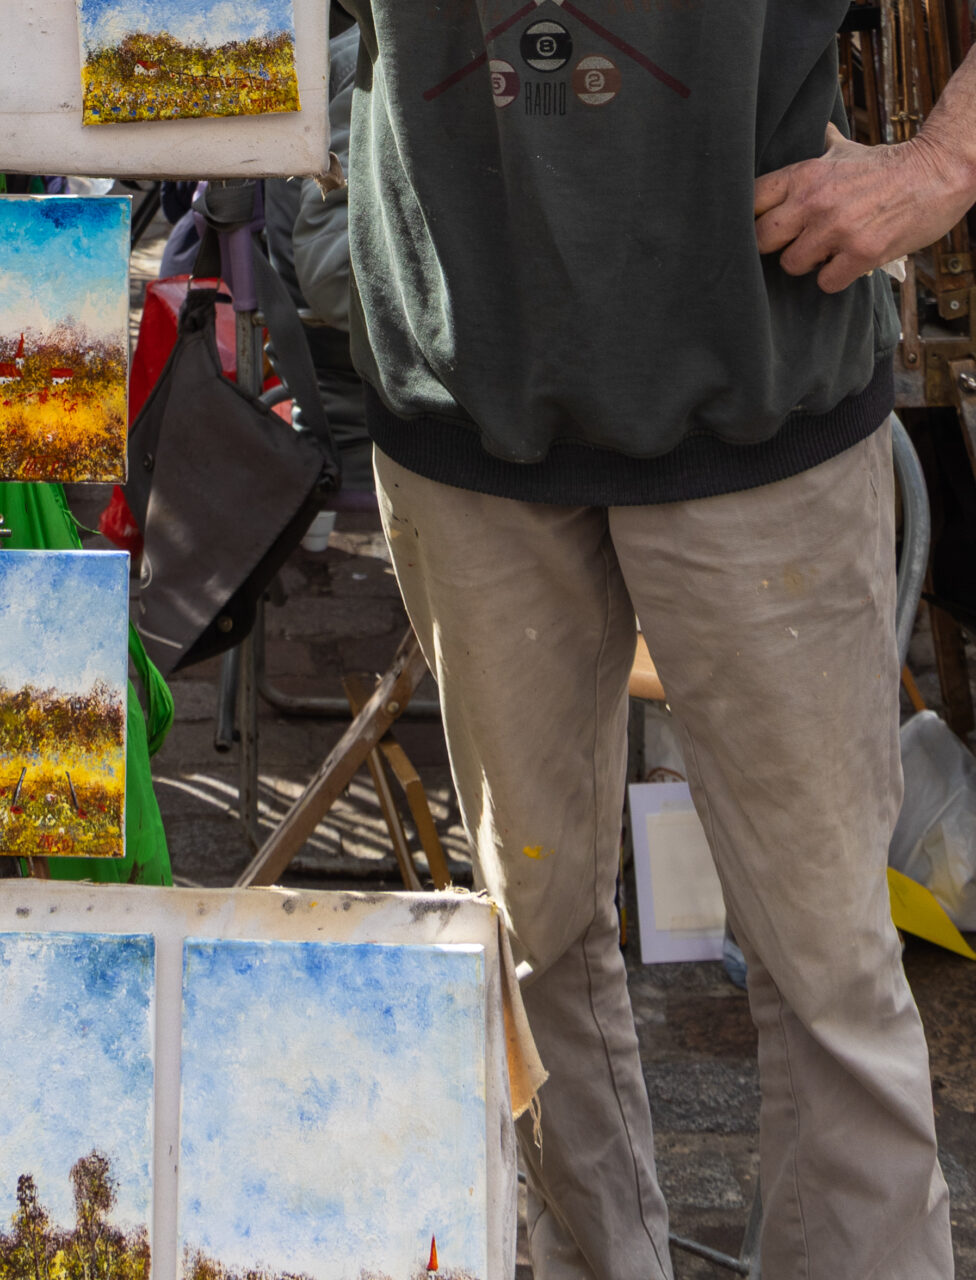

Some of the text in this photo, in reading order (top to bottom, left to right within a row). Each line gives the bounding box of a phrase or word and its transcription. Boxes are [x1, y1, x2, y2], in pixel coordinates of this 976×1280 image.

[539, 40, 554, 54] 8
[588, 73, 601, 88] 2
[525, 81, 566, 116] RADIO
